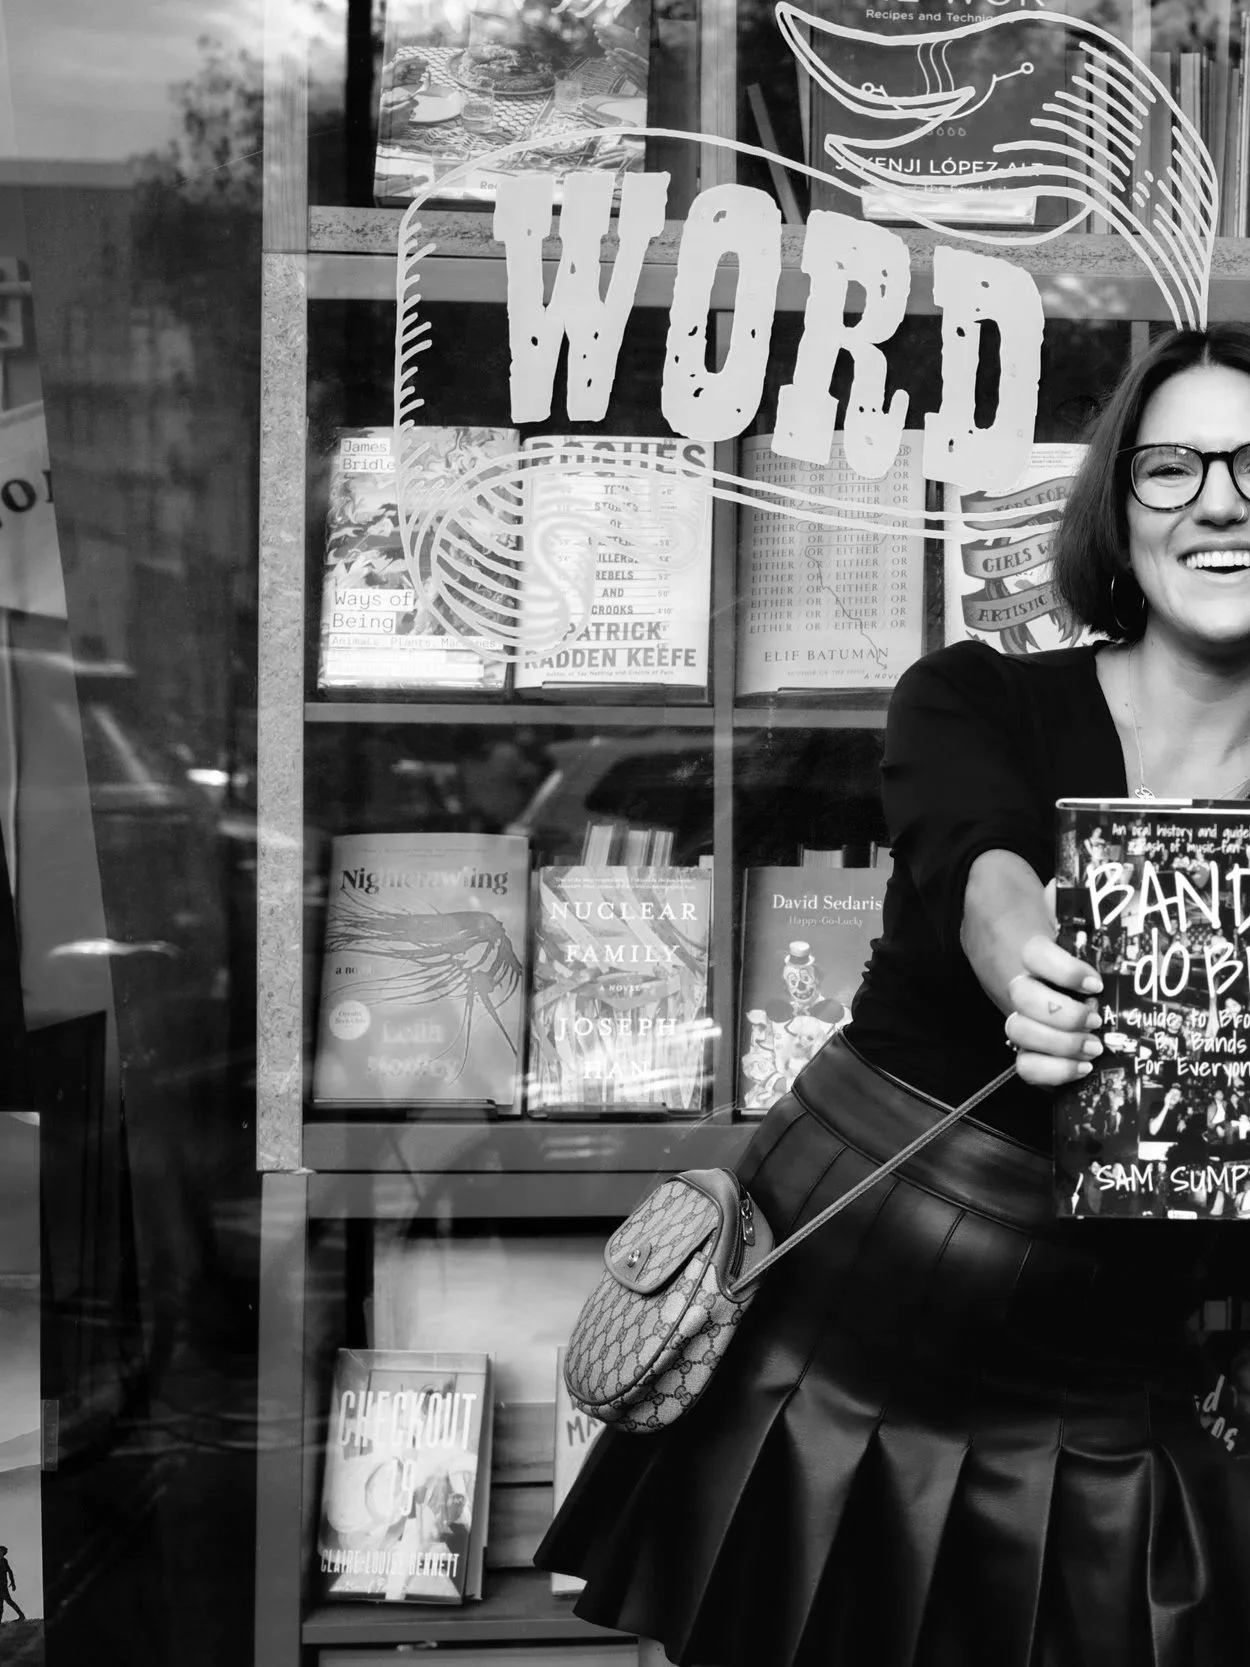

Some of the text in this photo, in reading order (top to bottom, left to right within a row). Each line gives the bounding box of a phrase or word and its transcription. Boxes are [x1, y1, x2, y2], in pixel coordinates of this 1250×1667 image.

[866, 9, 1016, 25] Recipes and Techni
[493, 171, 1045, 498] WORD
[344, 440, 387, 453] James
[343, 458, 396, 472] Bridle
[753, 532, 908, 546] EITHER OR EITHER OR
[597, 553, 640, 565] ILLERS,
[982, 547, 1032, 573] GIRLS
[595, 570, 634, 581] REBELS
[334, 590, 413, 609] Ways of
[601, 587, 625, 598] AND
[591, 604, 634, 615] CROOKS
[750, 607, 907, 622] EITHER OR EITHER OR
[978, 594, 1048, 622] ARTISTIC
[332, 612, 394, 632] Being
[562, 621, 662, 642] PATRICK
[524, 647, 697, 669] RADDEN KEEFE
[764, 648, 889, 662] ELIF BATUMAN
[874, 672, 900, 680] NOVE
[1112, 822, 1127, 836] An
[1156, 823, 1193, 843] history
[1197, 823, 1217, 839] and
[1169, 838, 1182, 853] of
[340, 867, 509, 895] Nightcrawling
[549, 902, 698, 921] NUCLEAR
[772, 894, 883, 911] David Sedaris
[788, 915, 864, 928] Happy-Go-Lucky
[564, 944, 680, 963] FAMILY
[335, 967, 342, 975] a
[599, 984, 643, 992] A NOVEL
[1103, 1004, 1116, 1026] A
[1127, 1005, 1184, 1028] Guide
[1191, 1007, 1207, 1029] to
[555, 1017, 678, 1042] JOSEPH
[1154, 1030, 1248, 1059] By Bands
[582, 1059, 653, 1080] HAN
[1134, 1056, 1165, 1076] For
[1096, 1163, 1154, 1192] SAM
[338, 1389, 478, 1451] CHECKOUT
[385, 1456, 417, 1517] 19
[408, 1551, 460, 1578] BENNETT
